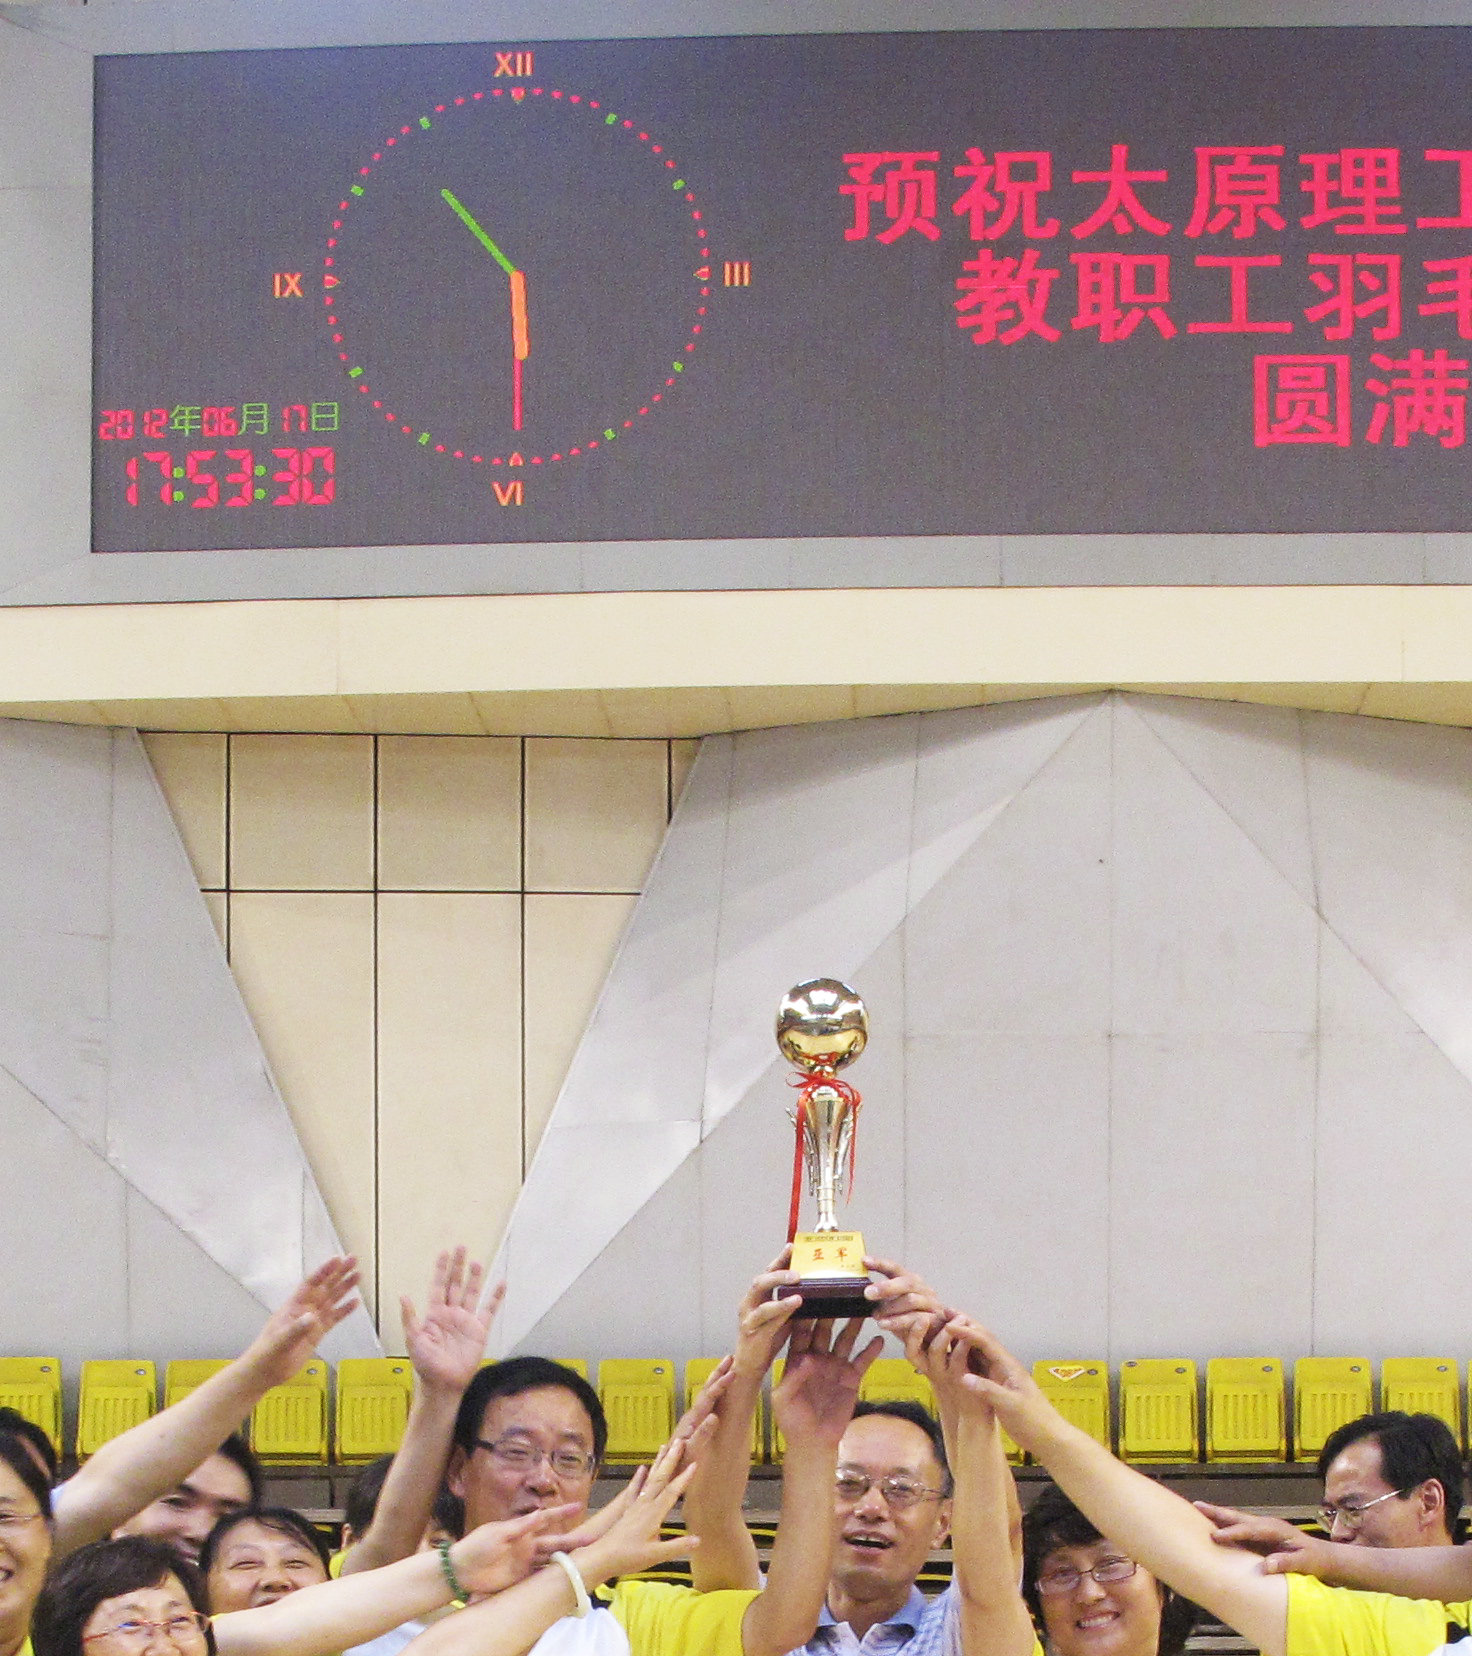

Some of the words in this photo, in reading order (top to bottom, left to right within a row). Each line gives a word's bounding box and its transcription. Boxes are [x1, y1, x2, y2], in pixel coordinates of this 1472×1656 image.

[494, 53, 534, 77] XII
[273, 272, 304, 298] IX
[723, 261, 751, 287] III
[126, 445, 336, 509] 17:53:30
[492, 481, 524, 507] VI
